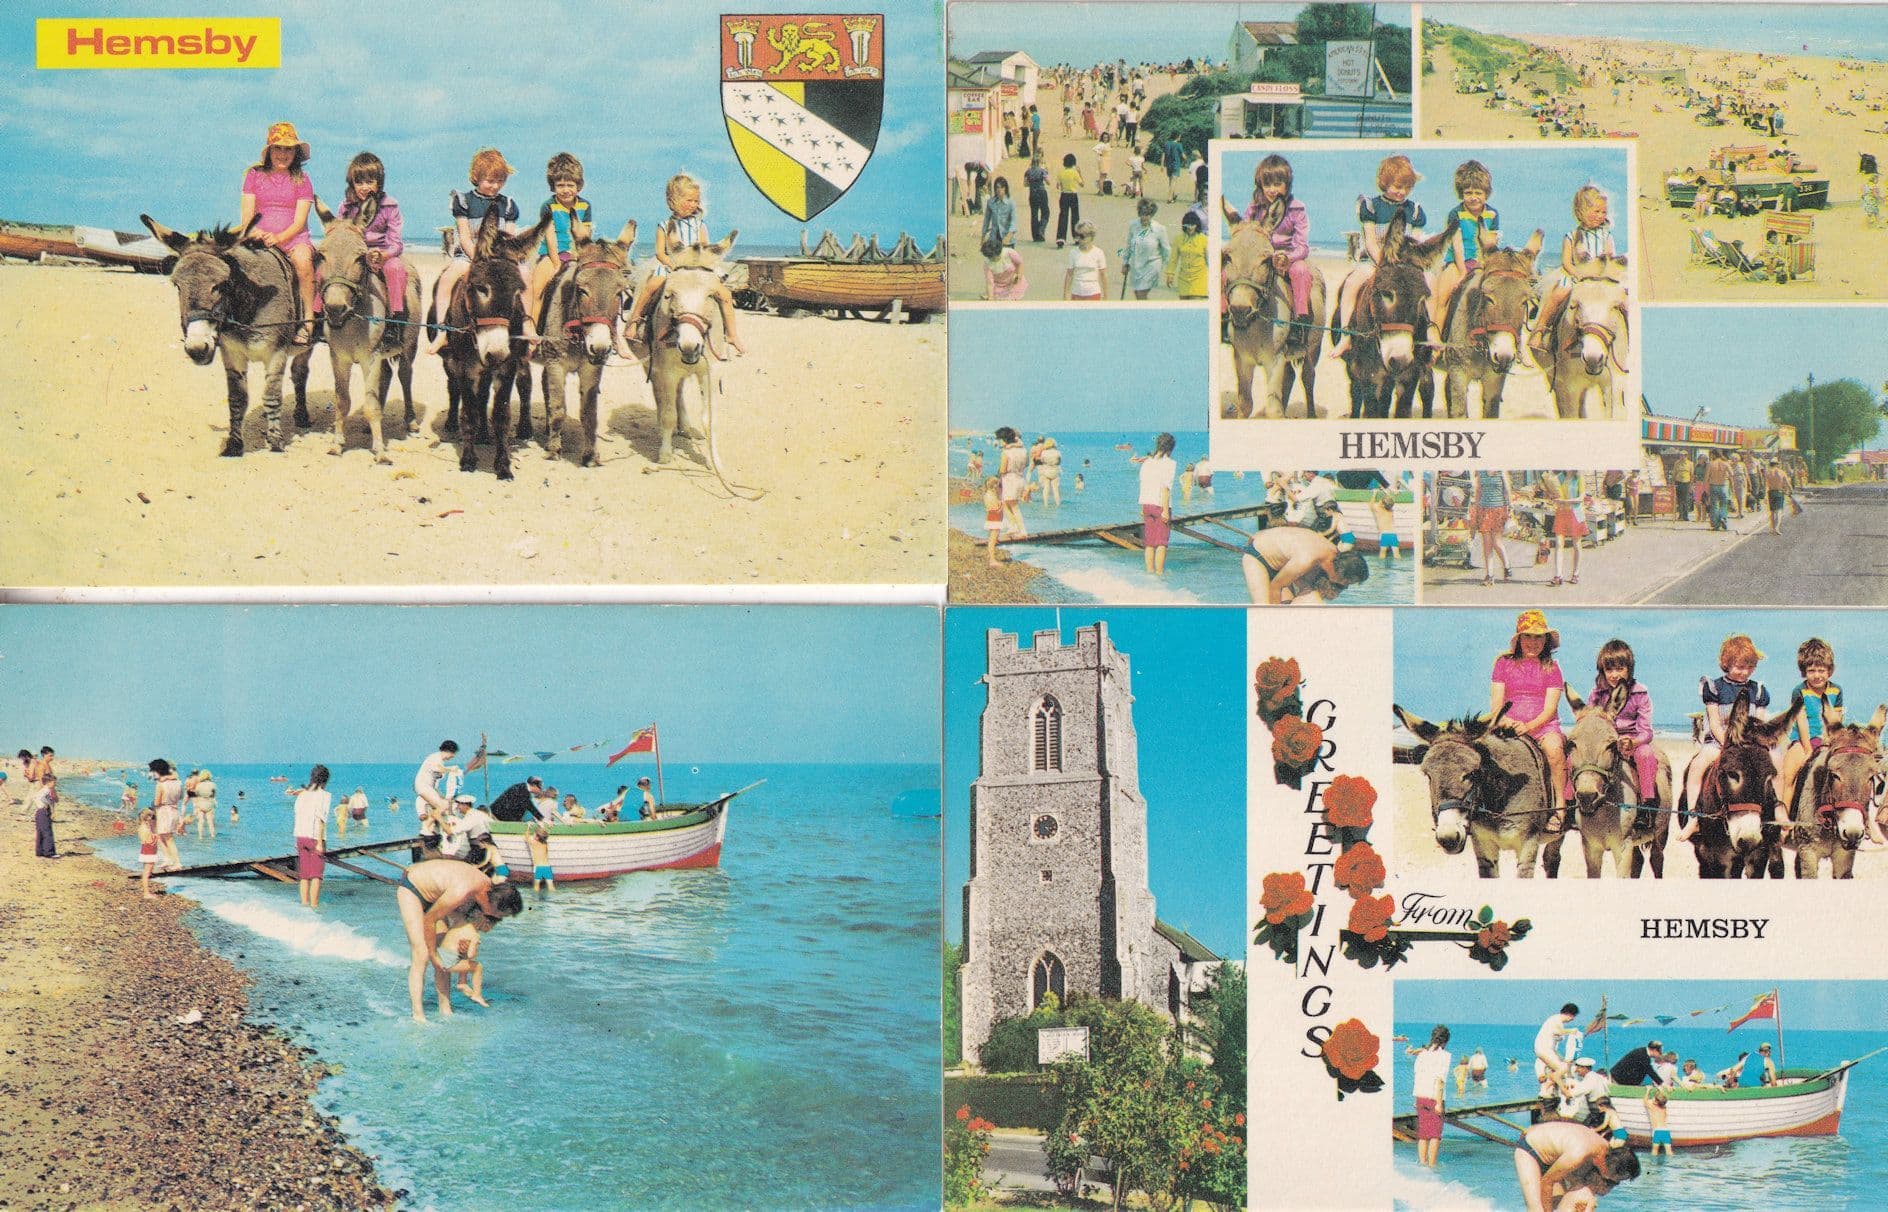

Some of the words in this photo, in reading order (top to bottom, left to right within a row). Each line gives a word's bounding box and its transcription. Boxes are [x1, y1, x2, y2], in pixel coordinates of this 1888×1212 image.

[67, 28, 258, 63] Hemsby
[1339, 431, 1486, 459] HEMSBY
[1300, 698, 1338, 1059] GREETINGS
[1399, 892, 1475, 931] From
[1640, 918, 1770, 939] HEMSBY
